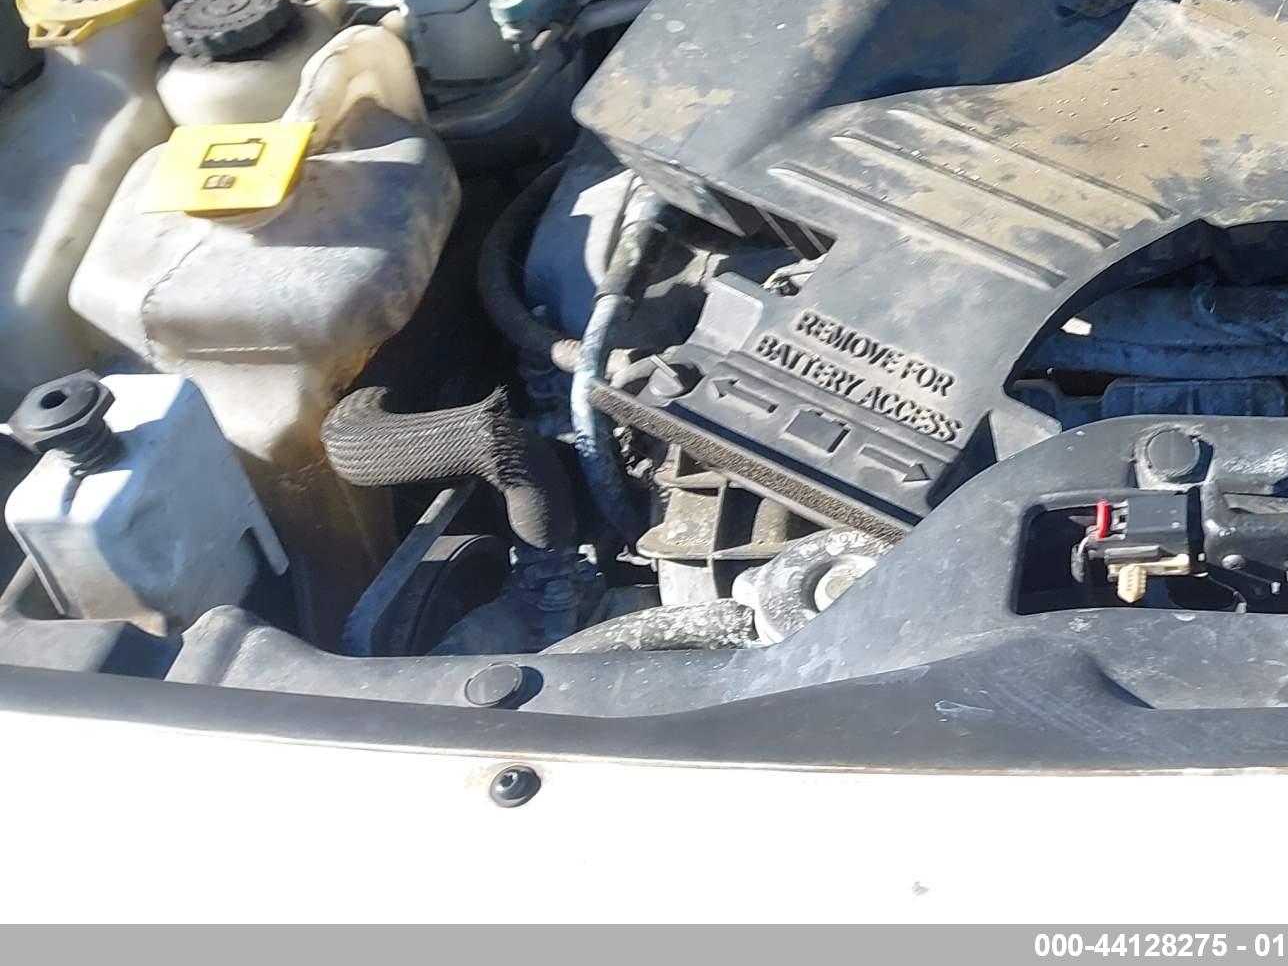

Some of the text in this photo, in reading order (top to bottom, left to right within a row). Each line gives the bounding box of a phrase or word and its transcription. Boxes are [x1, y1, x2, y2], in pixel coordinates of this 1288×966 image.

[756, 335, 962, 442] BATTERY ACCESS
[796, 309, 956, 397] REMOVE FOR
